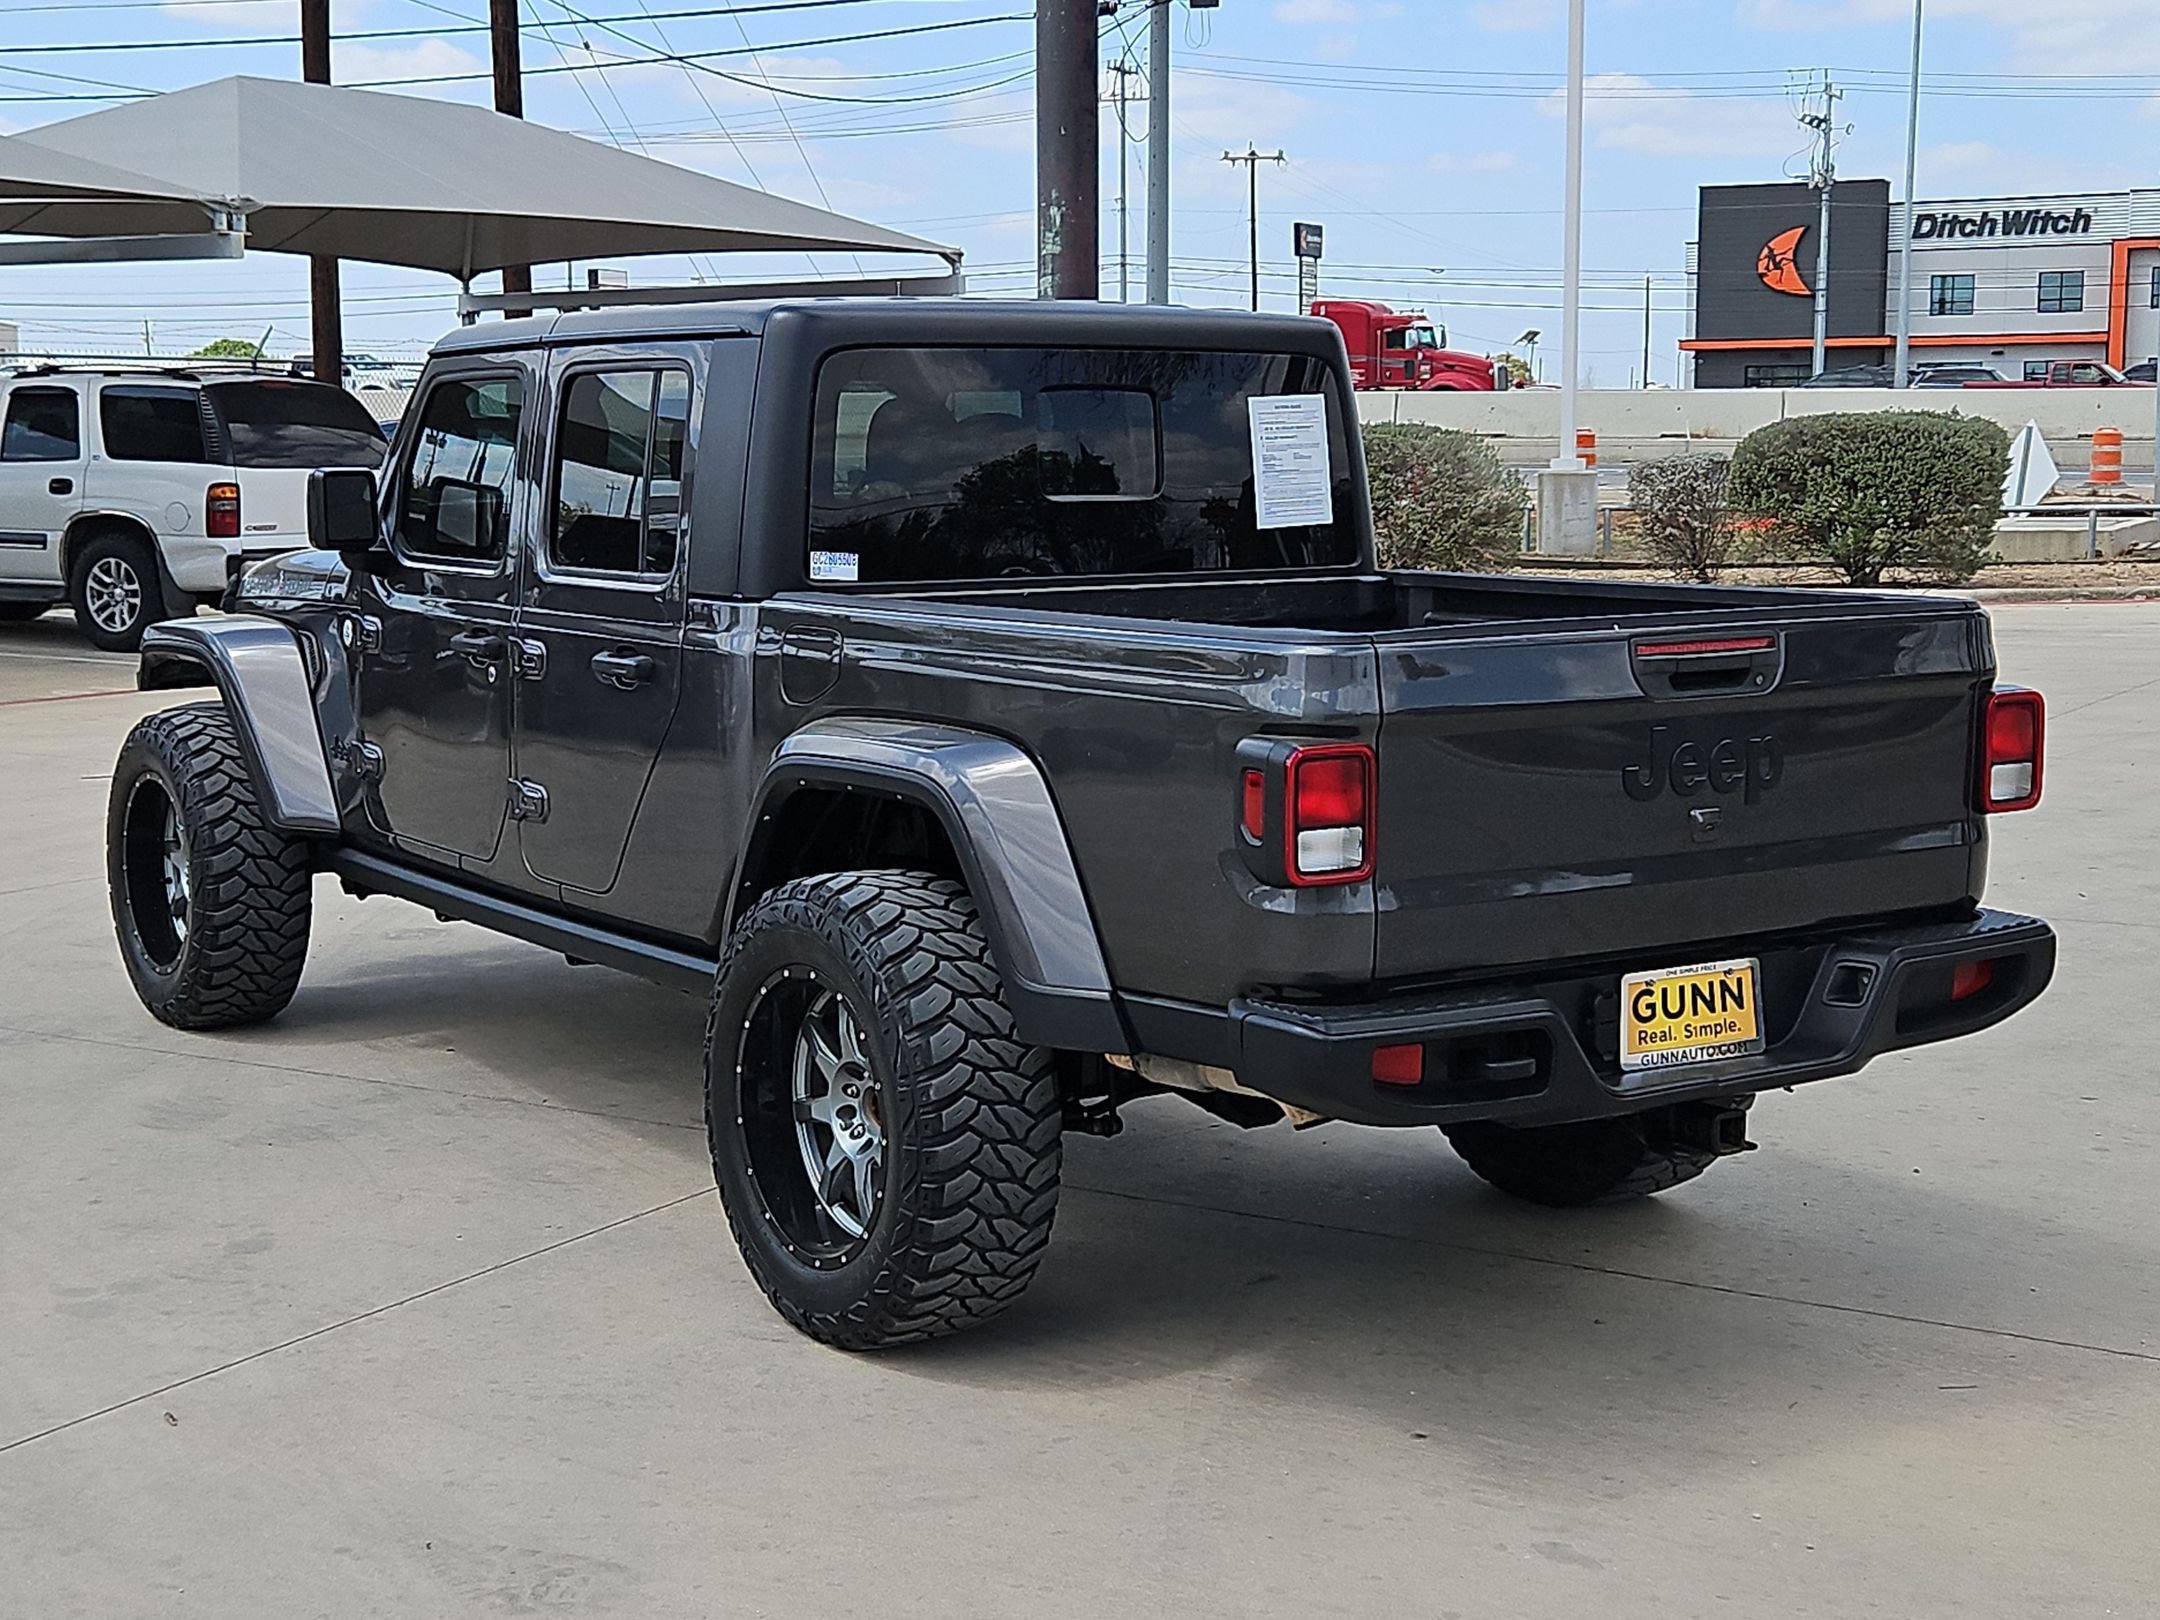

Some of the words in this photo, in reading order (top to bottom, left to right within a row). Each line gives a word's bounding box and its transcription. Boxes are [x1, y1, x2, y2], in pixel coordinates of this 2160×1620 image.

[1912, 211, 1998, 239] Ditch
[2001, 207, 2092, 236] Witch
[1622, 726, 1784, 805] Jeep
[1632, 977, 1745, 1024] GUNN
[1638, 1025, 1677, 1046] Real.
[1641, 1041, 1748, 1066] GUNNAUTO.COM
